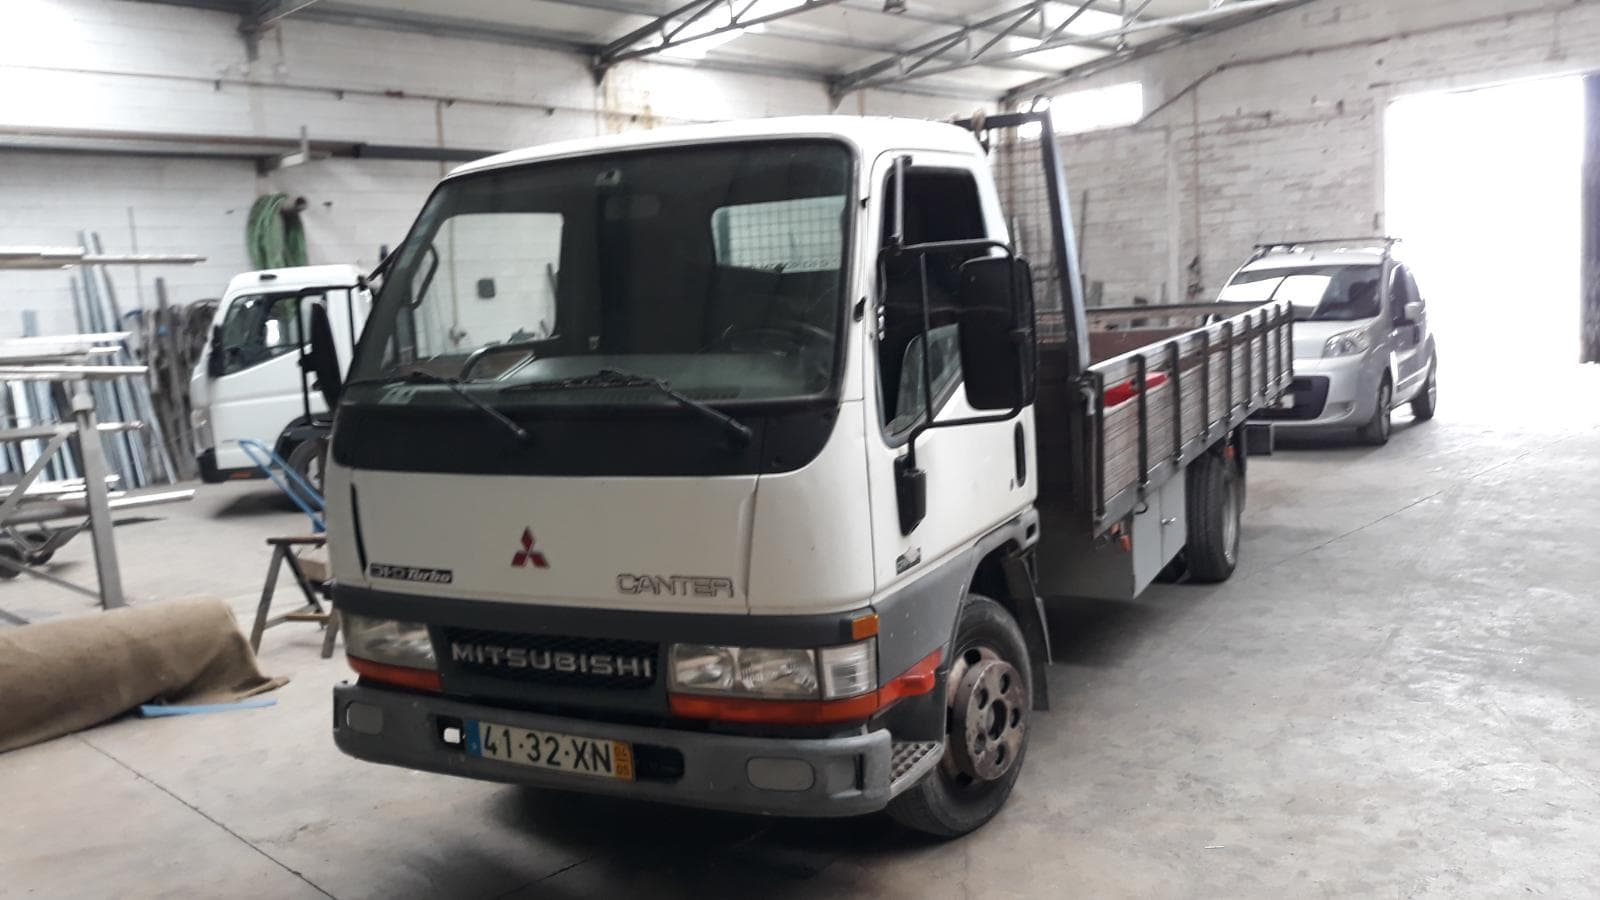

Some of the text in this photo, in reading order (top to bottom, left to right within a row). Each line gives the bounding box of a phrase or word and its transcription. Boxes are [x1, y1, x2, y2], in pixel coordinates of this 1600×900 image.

[406, 567, 452, 583] Turbo
[616, 573, 735, 598] CANTER
[451, 642, 652, 677] MITSUBISHI
